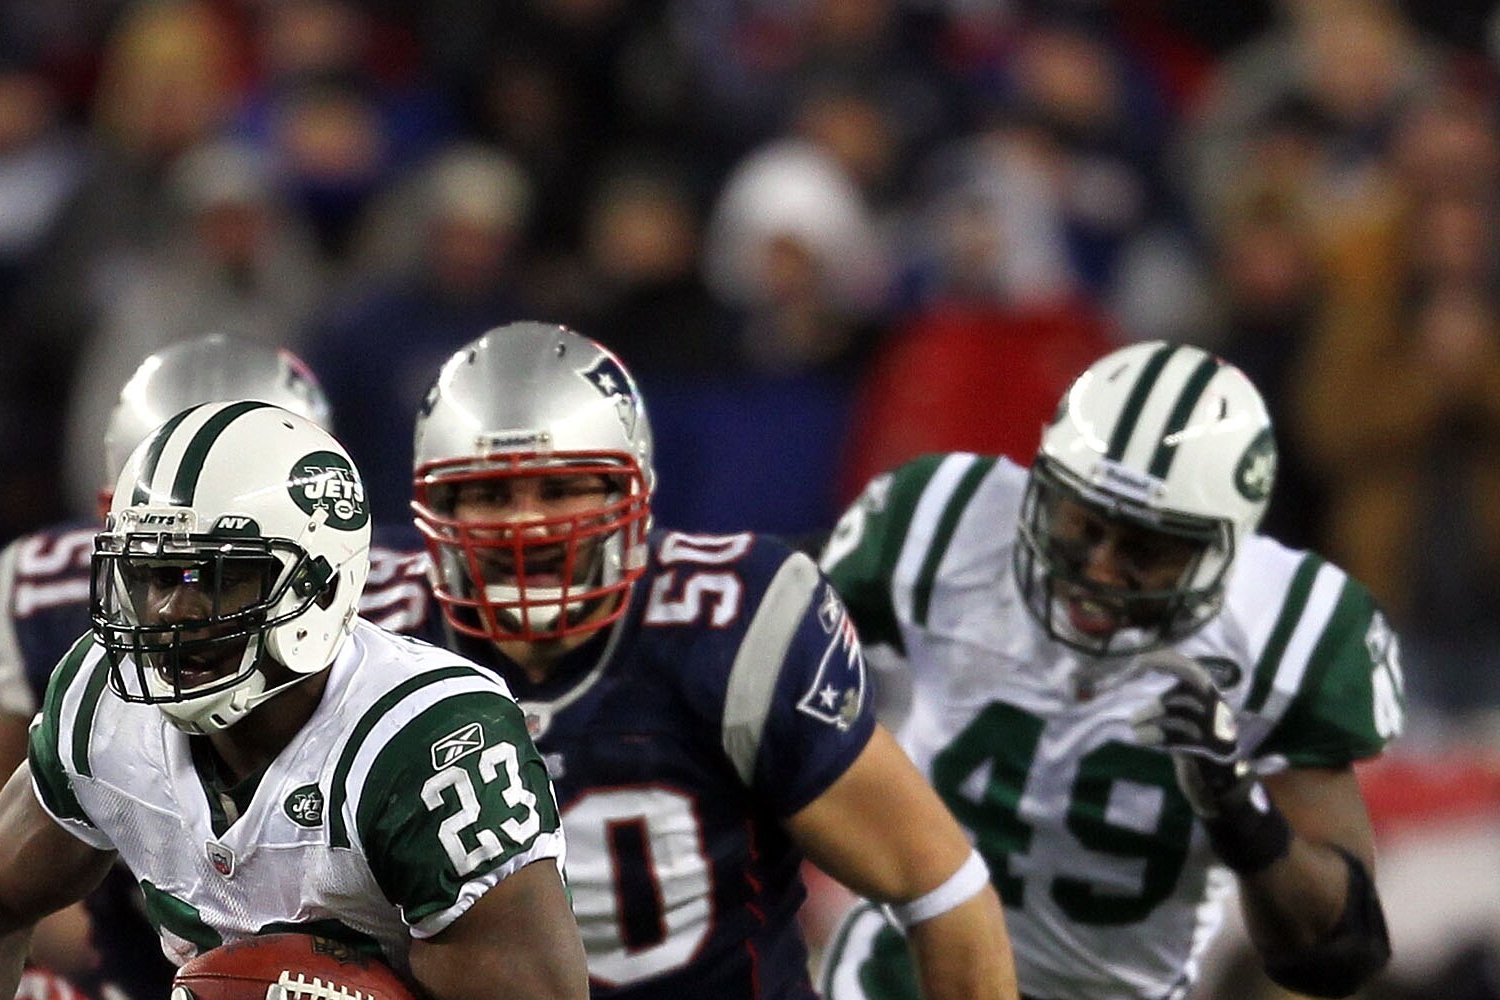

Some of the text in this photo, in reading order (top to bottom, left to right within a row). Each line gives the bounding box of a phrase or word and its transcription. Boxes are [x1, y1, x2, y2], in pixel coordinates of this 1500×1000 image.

[139, 513, 176, 525] JETS
[303, 478, 365, 503] JETS
[218, 517, 250, 530] NY
[644, 530, 756, 630] 50
[292, 798, 322, 813] JET
[419, 740, 544, 878] 23
[930, 700, 1197, 928] 49
[561, 783, 714, 988] 0
